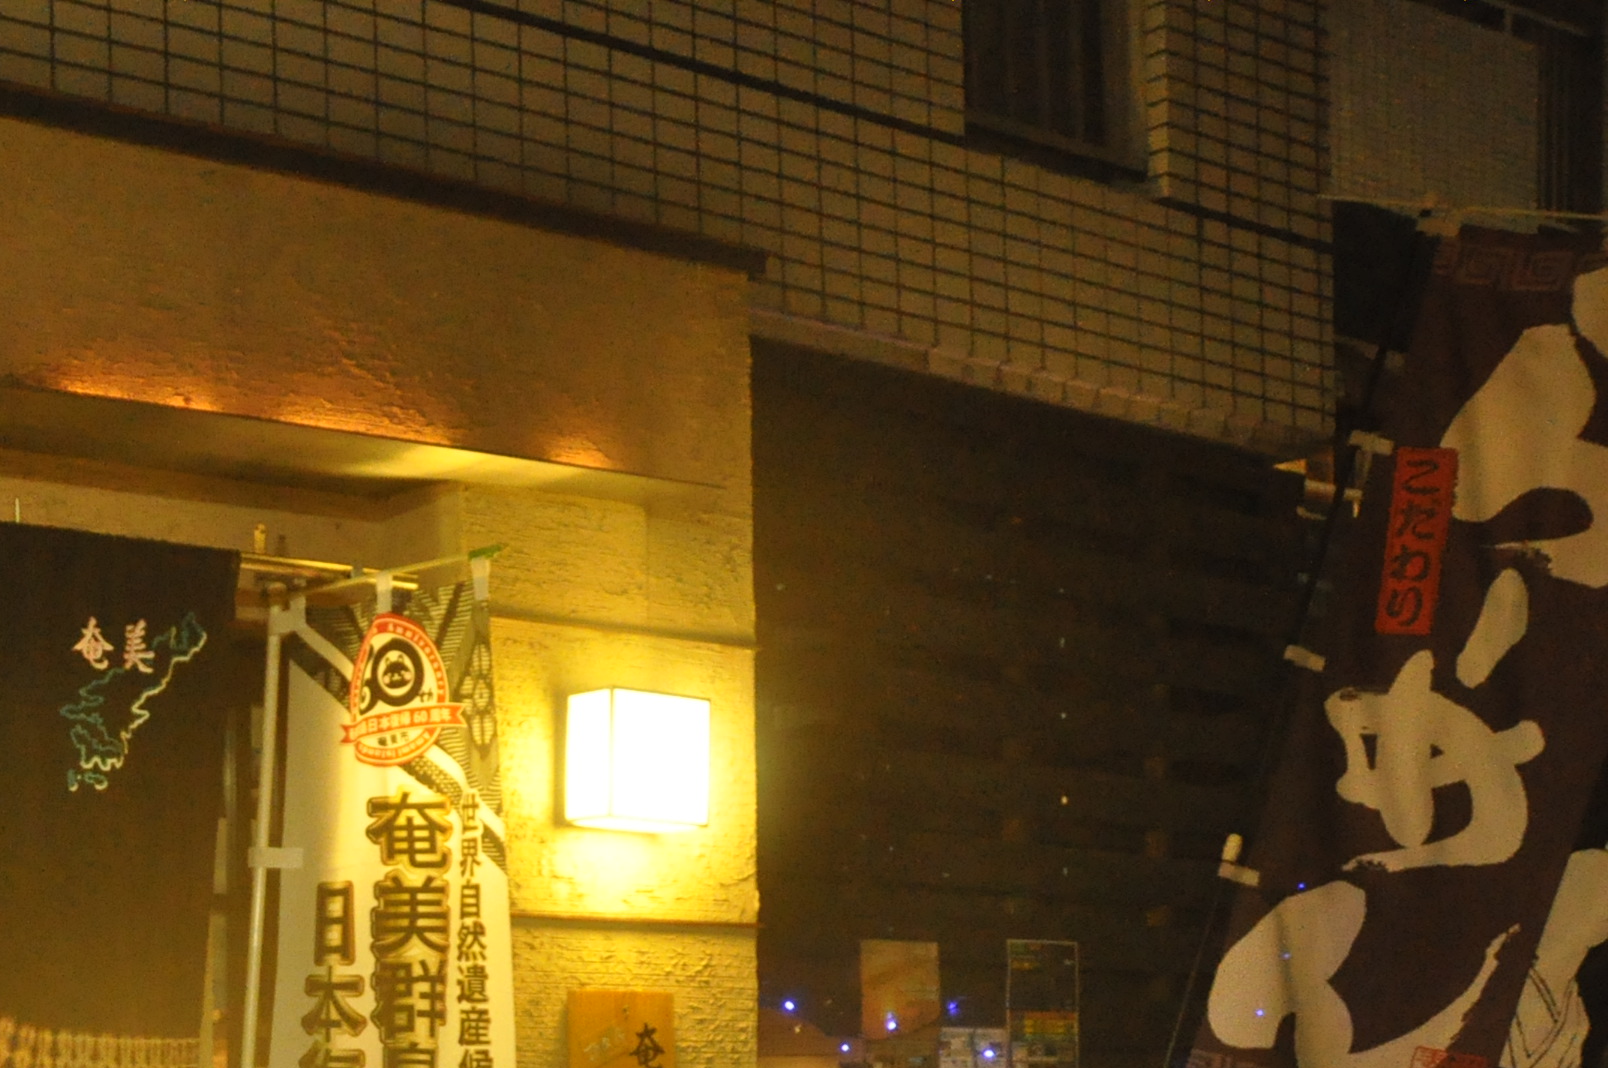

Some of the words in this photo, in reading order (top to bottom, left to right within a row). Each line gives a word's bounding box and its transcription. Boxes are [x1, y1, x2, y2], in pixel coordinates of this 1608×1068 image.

[1384, 457, 1442, 628] こだわり
[71, 615, 156, 674] 奄美
